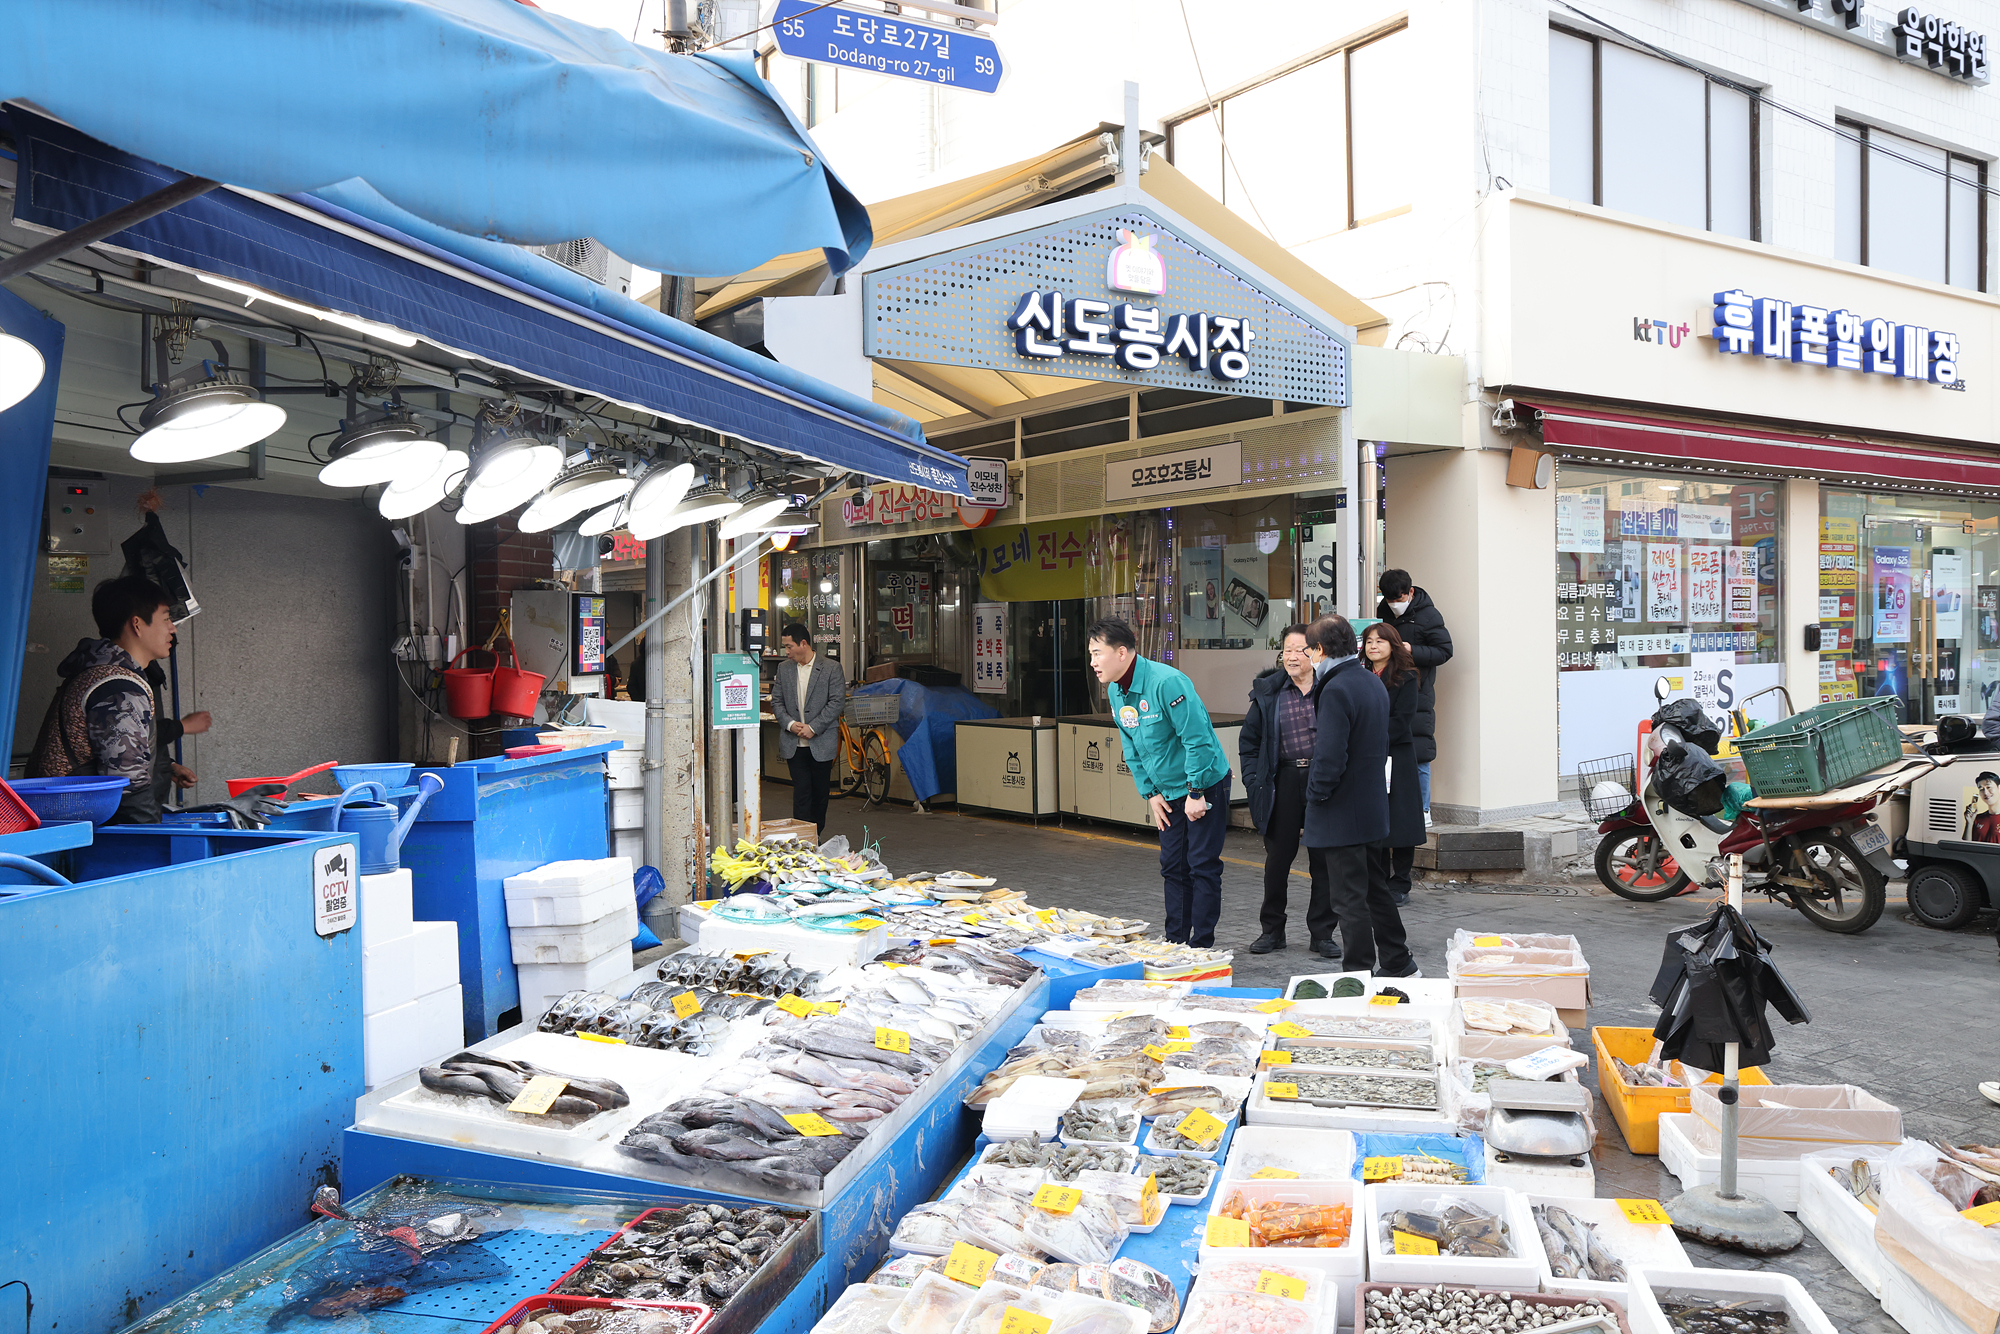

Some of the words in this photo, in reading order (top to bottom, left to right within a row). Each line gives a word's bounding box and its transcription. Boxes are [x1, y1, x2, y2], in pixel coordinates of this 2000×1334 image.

[782, 17, 805, 38] 55
[833, 15, 950, 60] 도당로27길
[1897, 6, 1988, 80] 음악학원
[828, 43, 910, 73] Dodang-ro
[914, 60, 956, 83] 27-gil
[974, 55, 995, 76] 59
[1008, 290, 1256, 382] 신도봉시장
[1633, 316, 1652, 343] kt
[1713, 288, 1960, 386] 휴대폰할인매장
[974, 471, 999, 482] 이모네
[1131, 457, 1212, 488] 오조호조통신
[970, 481, 1003, 494] 진수성찬
[1623, 510, 1676, 531] 전격출시
[1581, 538, 1601, 547] PHONE
[1583, 529, 1599, 537] USED
[977, 526, 1031, 579] 모네
[1651, 548, 1676, 569] 제일
[1741, 550, 1756, 560] 인터넷
[1875, 555, 1898, 567] Galaxy
[1897, 555, 1909, 565] S25
[1303, 566, 1317, 578] 럭시
[1317, 554, 1333, 590] S
[1690, 551, 1720, 575] 무료폰
[1741, 567, 1756, 577] 핸드폰
[887, 573, 919, 596] 후암
[1651, 569, 1677, 591] 싼집
[1692, 577, 1718, 601] 다량
[1558, 582, 1616, 599] 필름교체무료
[1559, 605, 1615, 622] 요금수납
[1650, 603, 1679, 619] 1층매장
[891, 602, 914, 641] 떡
[1559, 628, 1615, 645] 무료충전
[1559, 650, 1615, 668] 인터넷설치
[976, 661, 1004, 681] 전복죽
[1693, 684, 1716, 699] 갤럭시
[1716, 668, 1734, 710] S
[1082, 760, 1104, 771] 신도봉시장
[1116, 763, 1131, 774] 신도봉
[1001, 775, 1026, 786] 신도봉시장
[322, 880, 349, 899] CCTV
[325, 896, 347, 913] 촬영중
